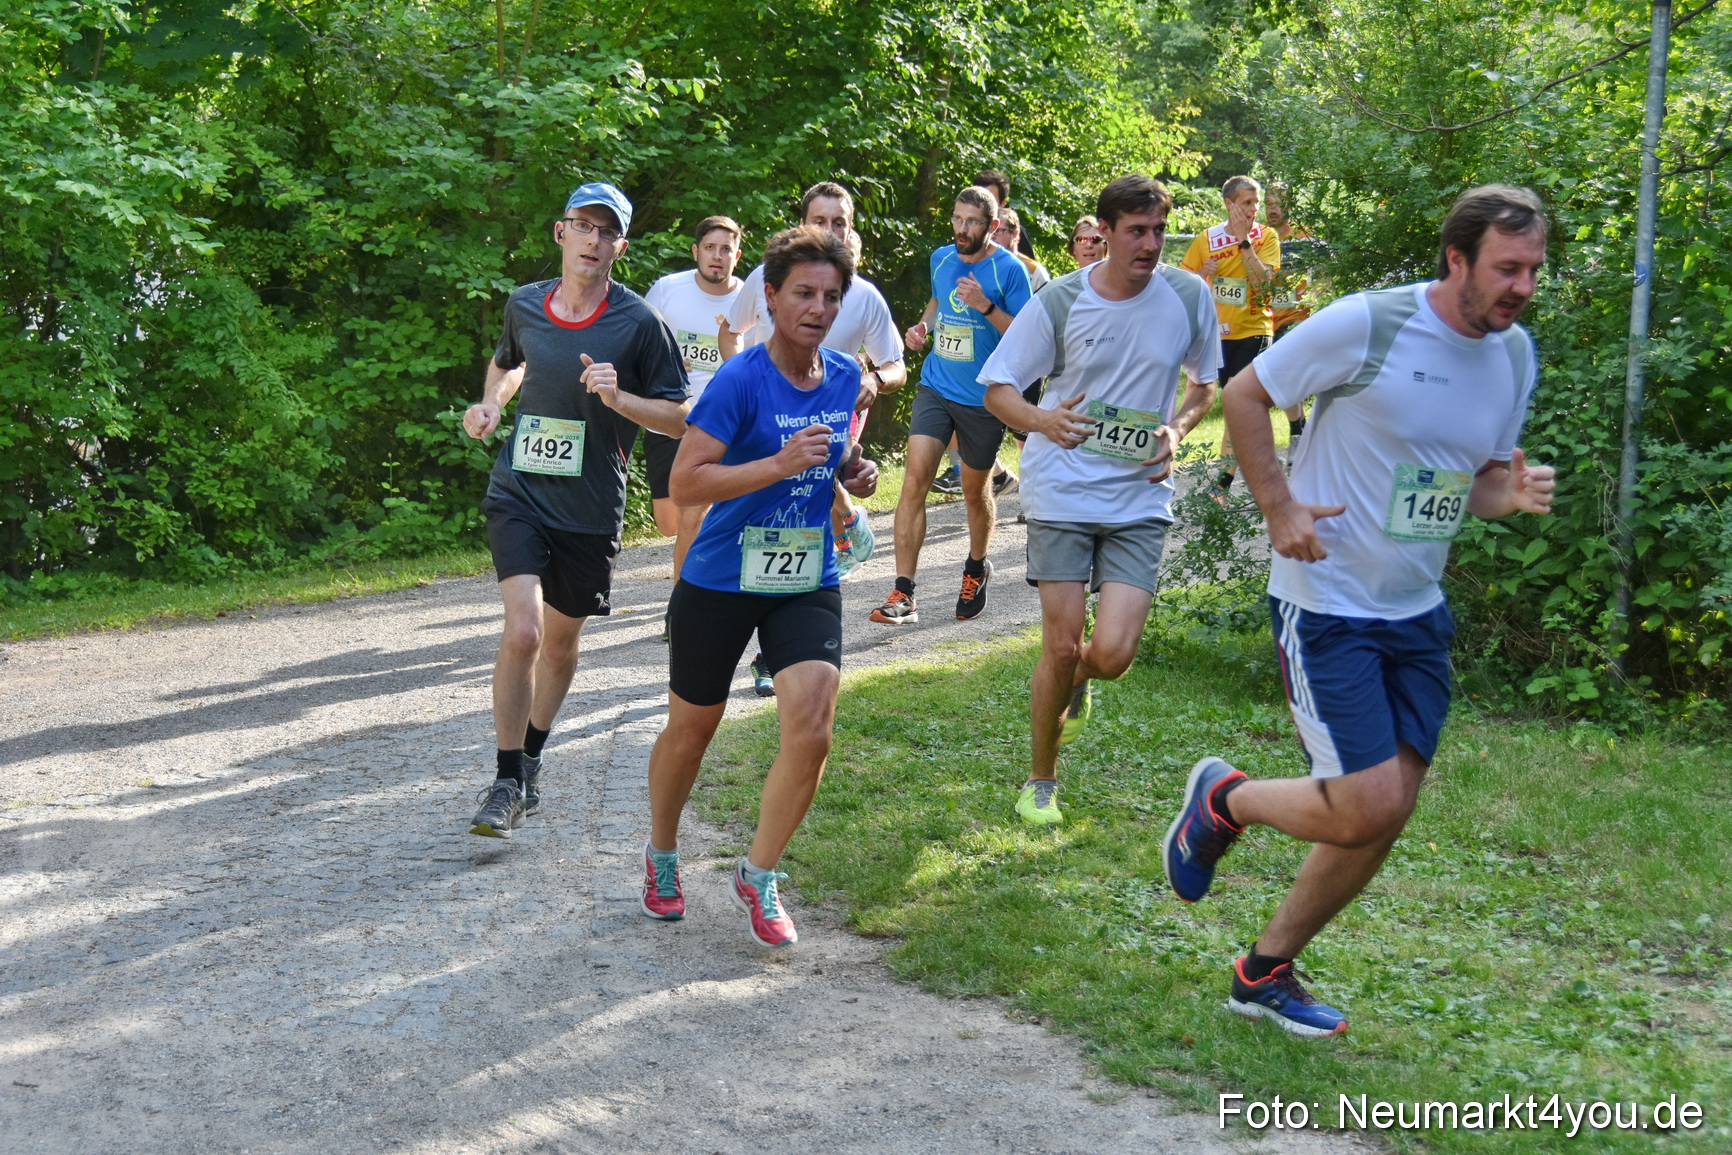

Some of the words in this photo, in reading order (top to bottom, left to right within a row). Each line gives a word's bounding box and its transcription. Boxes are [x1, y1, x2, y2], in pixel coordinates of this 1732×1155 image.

[1215, 286, 1242, 298] 1646
[940, 335, 962, 351] 977
[682, 344, 718, 362] 1368
[775, 414, 808, 428] Wenn
[810, 415, 820, 425] es
[821, 410, 848, 424] beim
[1095, 422, 1148, 448] 1470
[522, 436, 573, 460] 1492
[1100, 442, 1118, 450] Lerzer
[790, 484, 813, 496] soll!
[1404, 493, 1462, 522] 1469
[1412, 521, 1432, 529] Lerzer
[762, 552, 807, 574] 727
